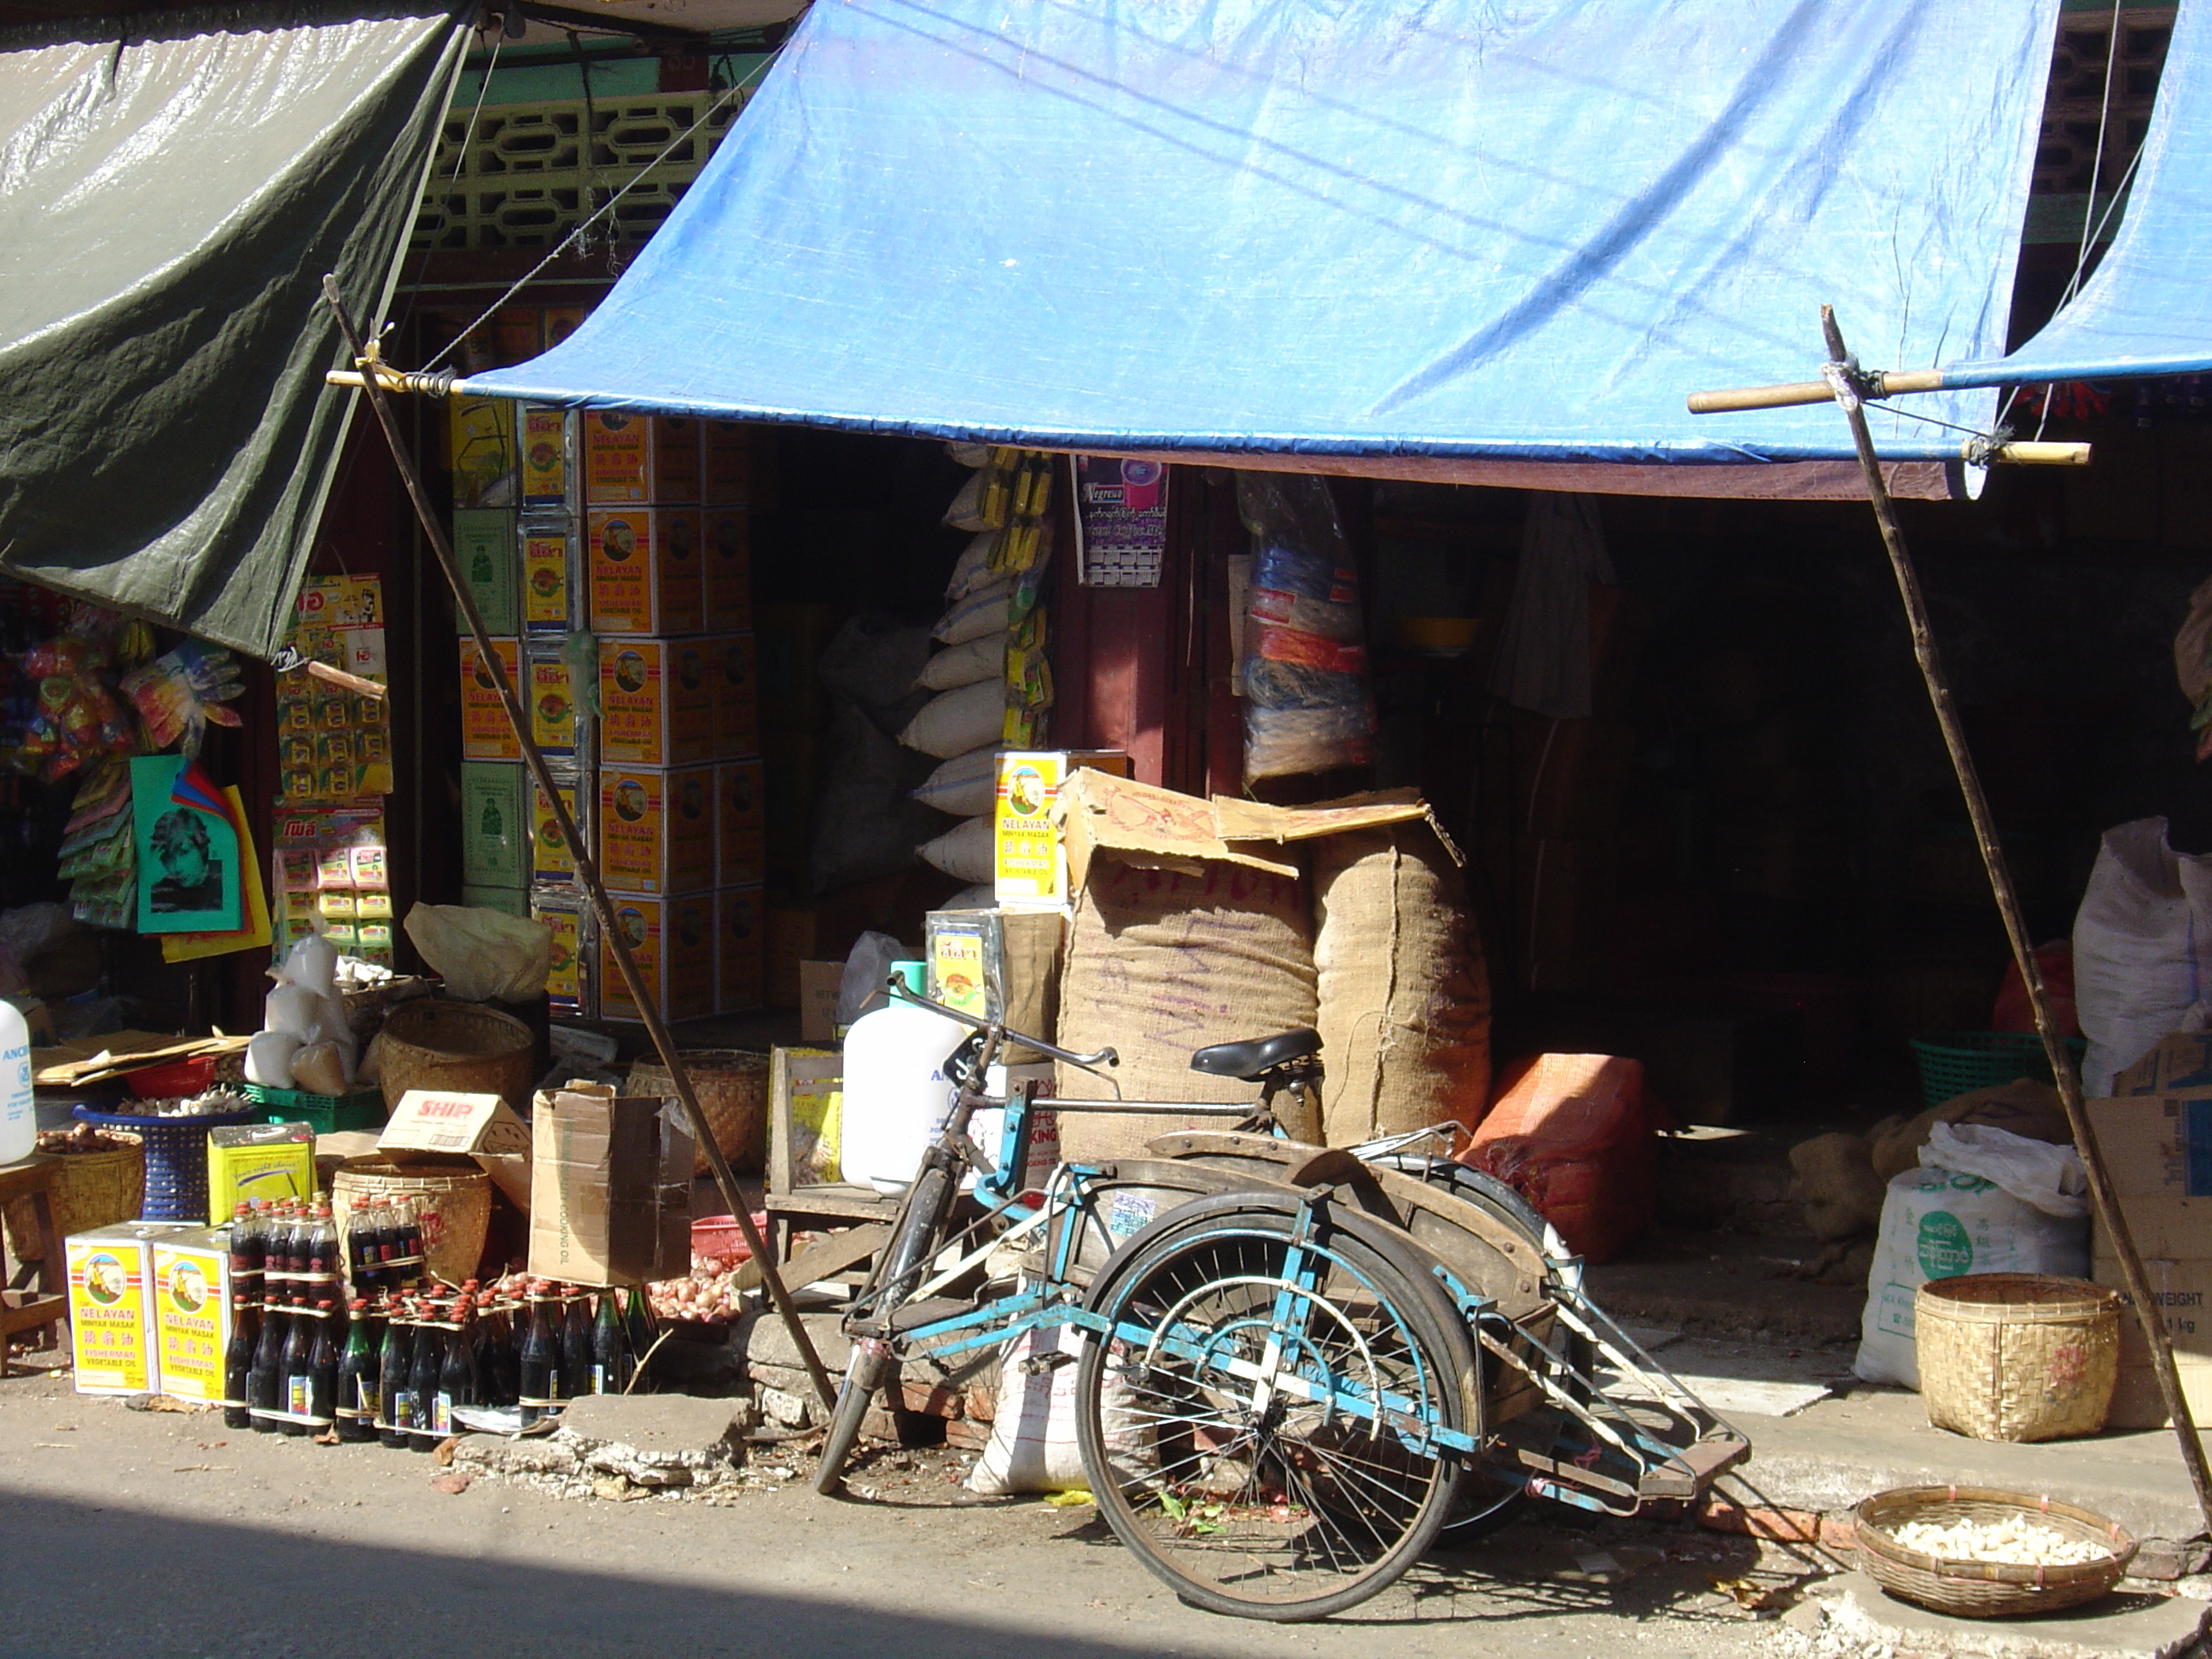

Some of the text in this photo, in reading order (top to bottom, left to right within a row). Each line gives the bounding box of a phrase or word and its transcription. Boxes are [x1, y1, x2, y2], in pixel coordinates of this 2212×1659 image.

[592, 434, 638, 443] NELAYAN
[1083, 482, 1123, 502] Negresco
[596, 565, 642, 574] NELAYAN
[468, 692, 501, 701] NELAYA
[608, 696, 653, 705] NELAYAN
[608, 824, 654, 835] NELAYAN
[1003, 819, 1050, 830] NELAYAN
[417, 1099, 474, 1120] SHIP
[1030, 1128, 1057, 1144] KING
[253, 1163, 271, 1173] right
[273, 1160, 300, 1168] choice!
[560, 1163, 570, 1202] QUALITY
[560, 1204, 569, 1248] COOKING
[560, 1250, 569, 1266] OIL
[2154, 1292, 2203, 1306] WEIGHT
[80, 1308, 135, 1320] NELAYAN
[109, 1320, 135, 1329] MASAK
[166, 1313, 214, 1330] NELAYAN
[2178, 1318, 2195, 1333] kg
[166, 1325, 214, 1339] MINYAK MASAK
[85, 1349, 136, 1359] FISHERMAN
[86, 1358, 123, 1366] VEGETABLE
[169, 1355, 215, 1369] FISHERMAN
[170, 1364, 202, 1376] VEGETABLE
